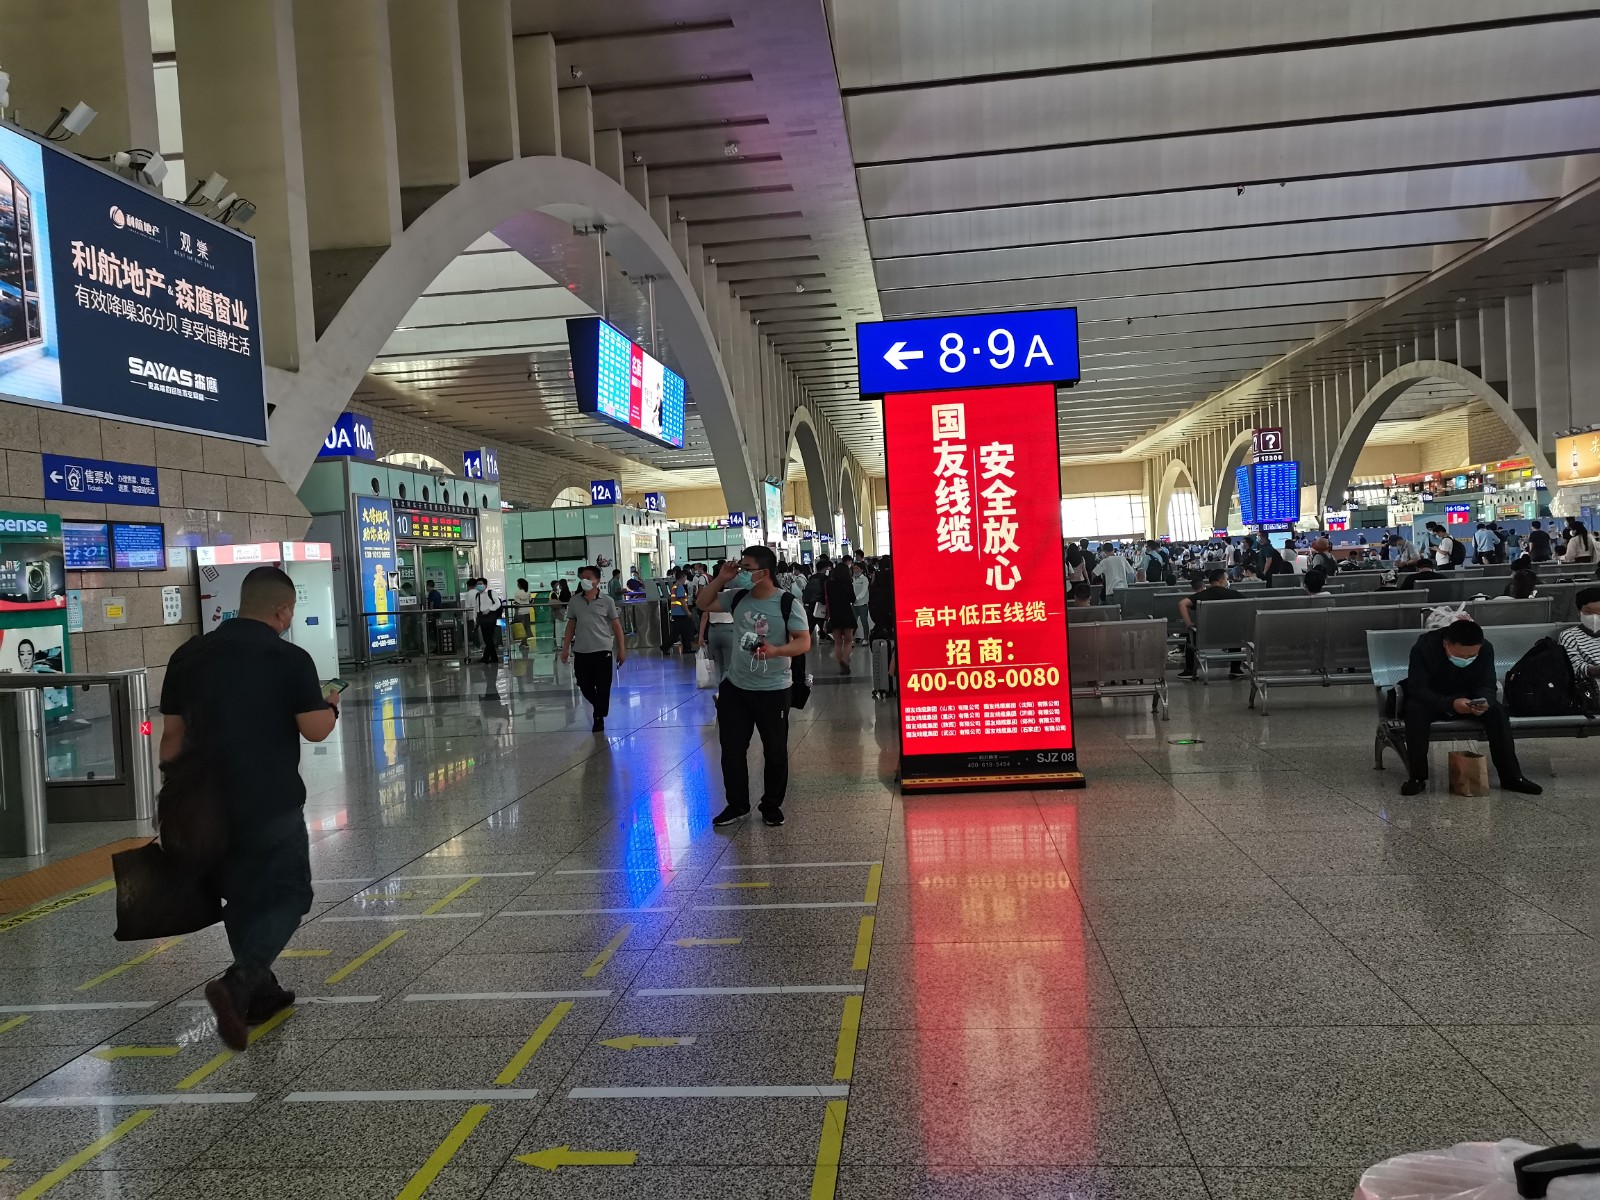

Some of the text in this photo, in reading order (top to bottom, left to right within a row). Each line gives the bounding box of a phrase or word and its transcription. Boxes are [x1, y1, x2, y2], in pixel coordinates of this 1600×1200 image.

[74, 283, 251, 356] 有效降噪36分贝 享受恒静生活
[128, 356, 193, 388] SAYYAS
[354, 422, 374, 451] 10A
[486, 453, 499, 475] 11A
[84, 469, 114, 485] 售票处
[931, 402, 974, 553] 国友线缆
[591, 484, 612, 500] 12A
[396, 516, 408, 534] 10
[729, 514, 743, 525] 14A
[979, 441, 1022, 591] 安全放心
[464, 522, 472, 538] 11
[914, 601, 1047, 628] 高中低压线缆
[907, 667, 1060, 692] 400-008-0080
[1036, 752, 1075, 763] SJZ 08
